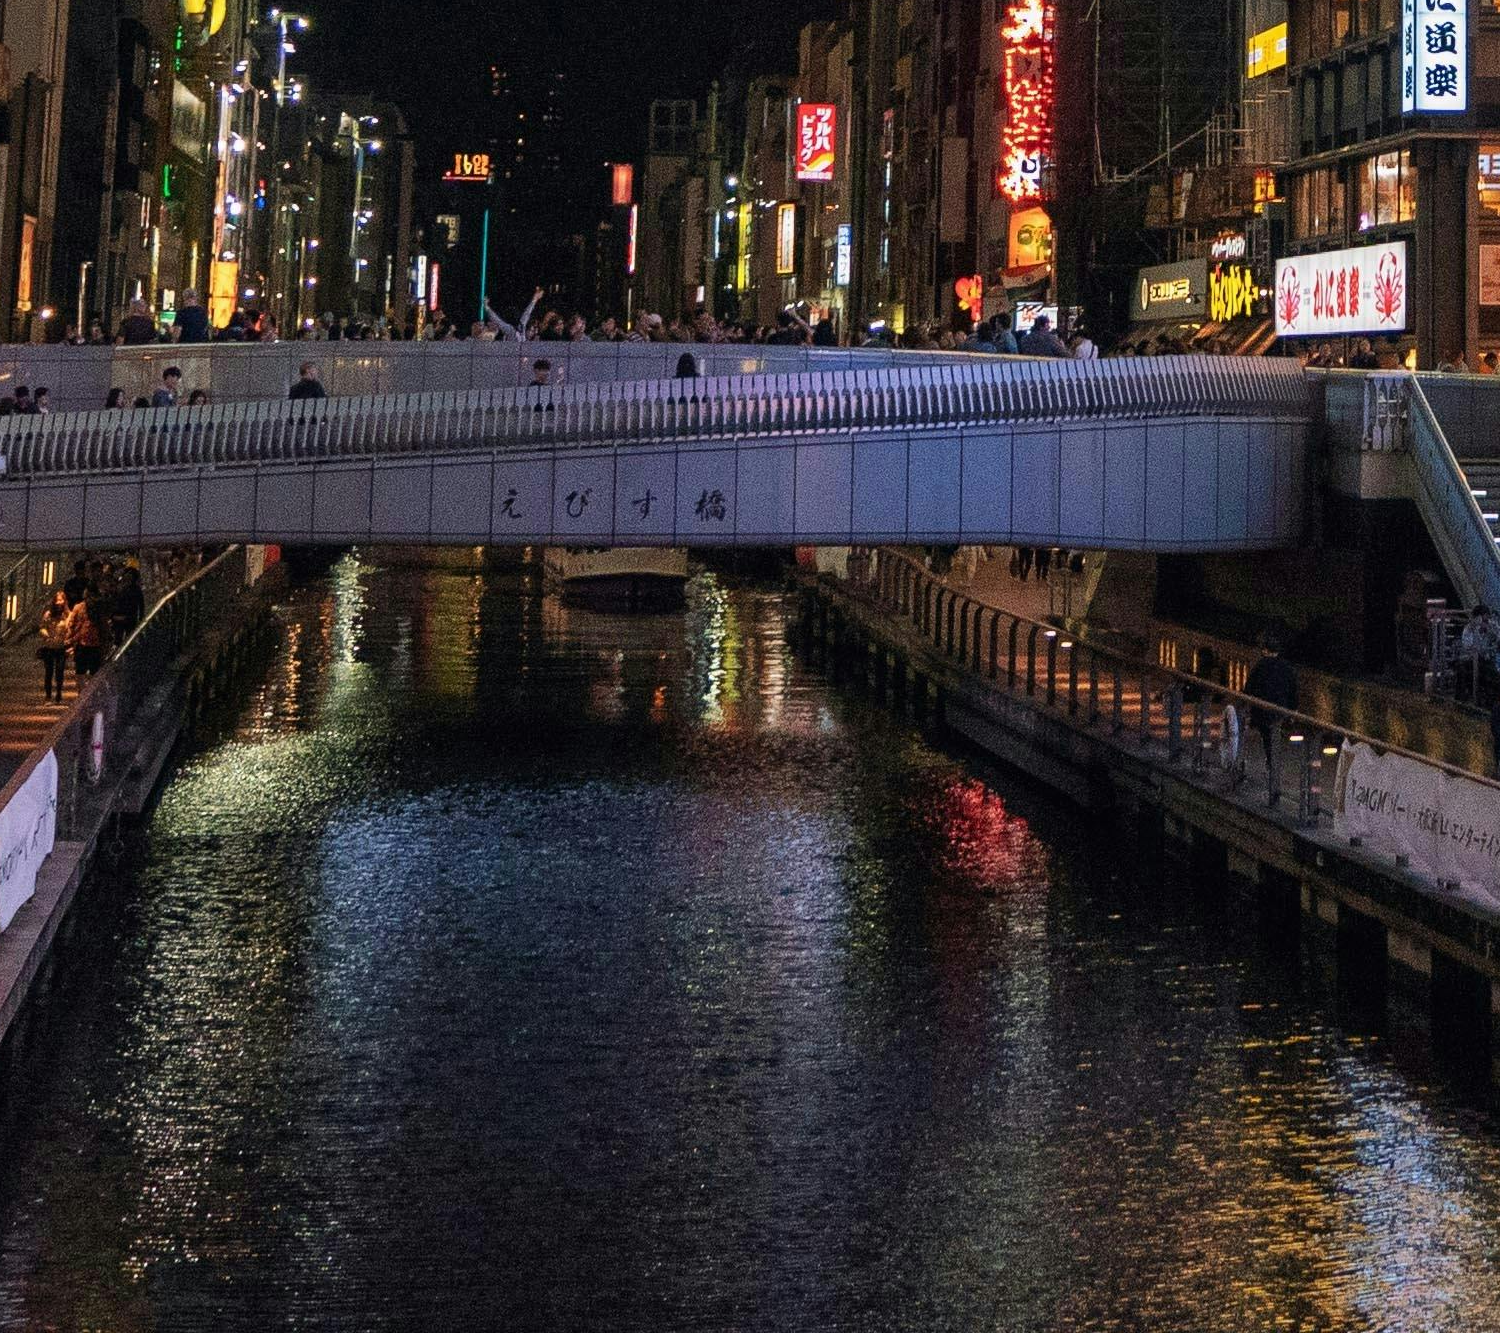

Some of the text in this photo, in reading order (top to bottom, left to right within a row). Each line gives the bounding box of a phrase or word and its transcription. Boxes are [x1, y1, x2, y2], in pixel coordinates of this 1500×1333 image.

[816, 106, 832, 152] ツルハ
[1313, 264, 1360, 322] かに道楽
[502, 488, 727, 522] えびす橋
